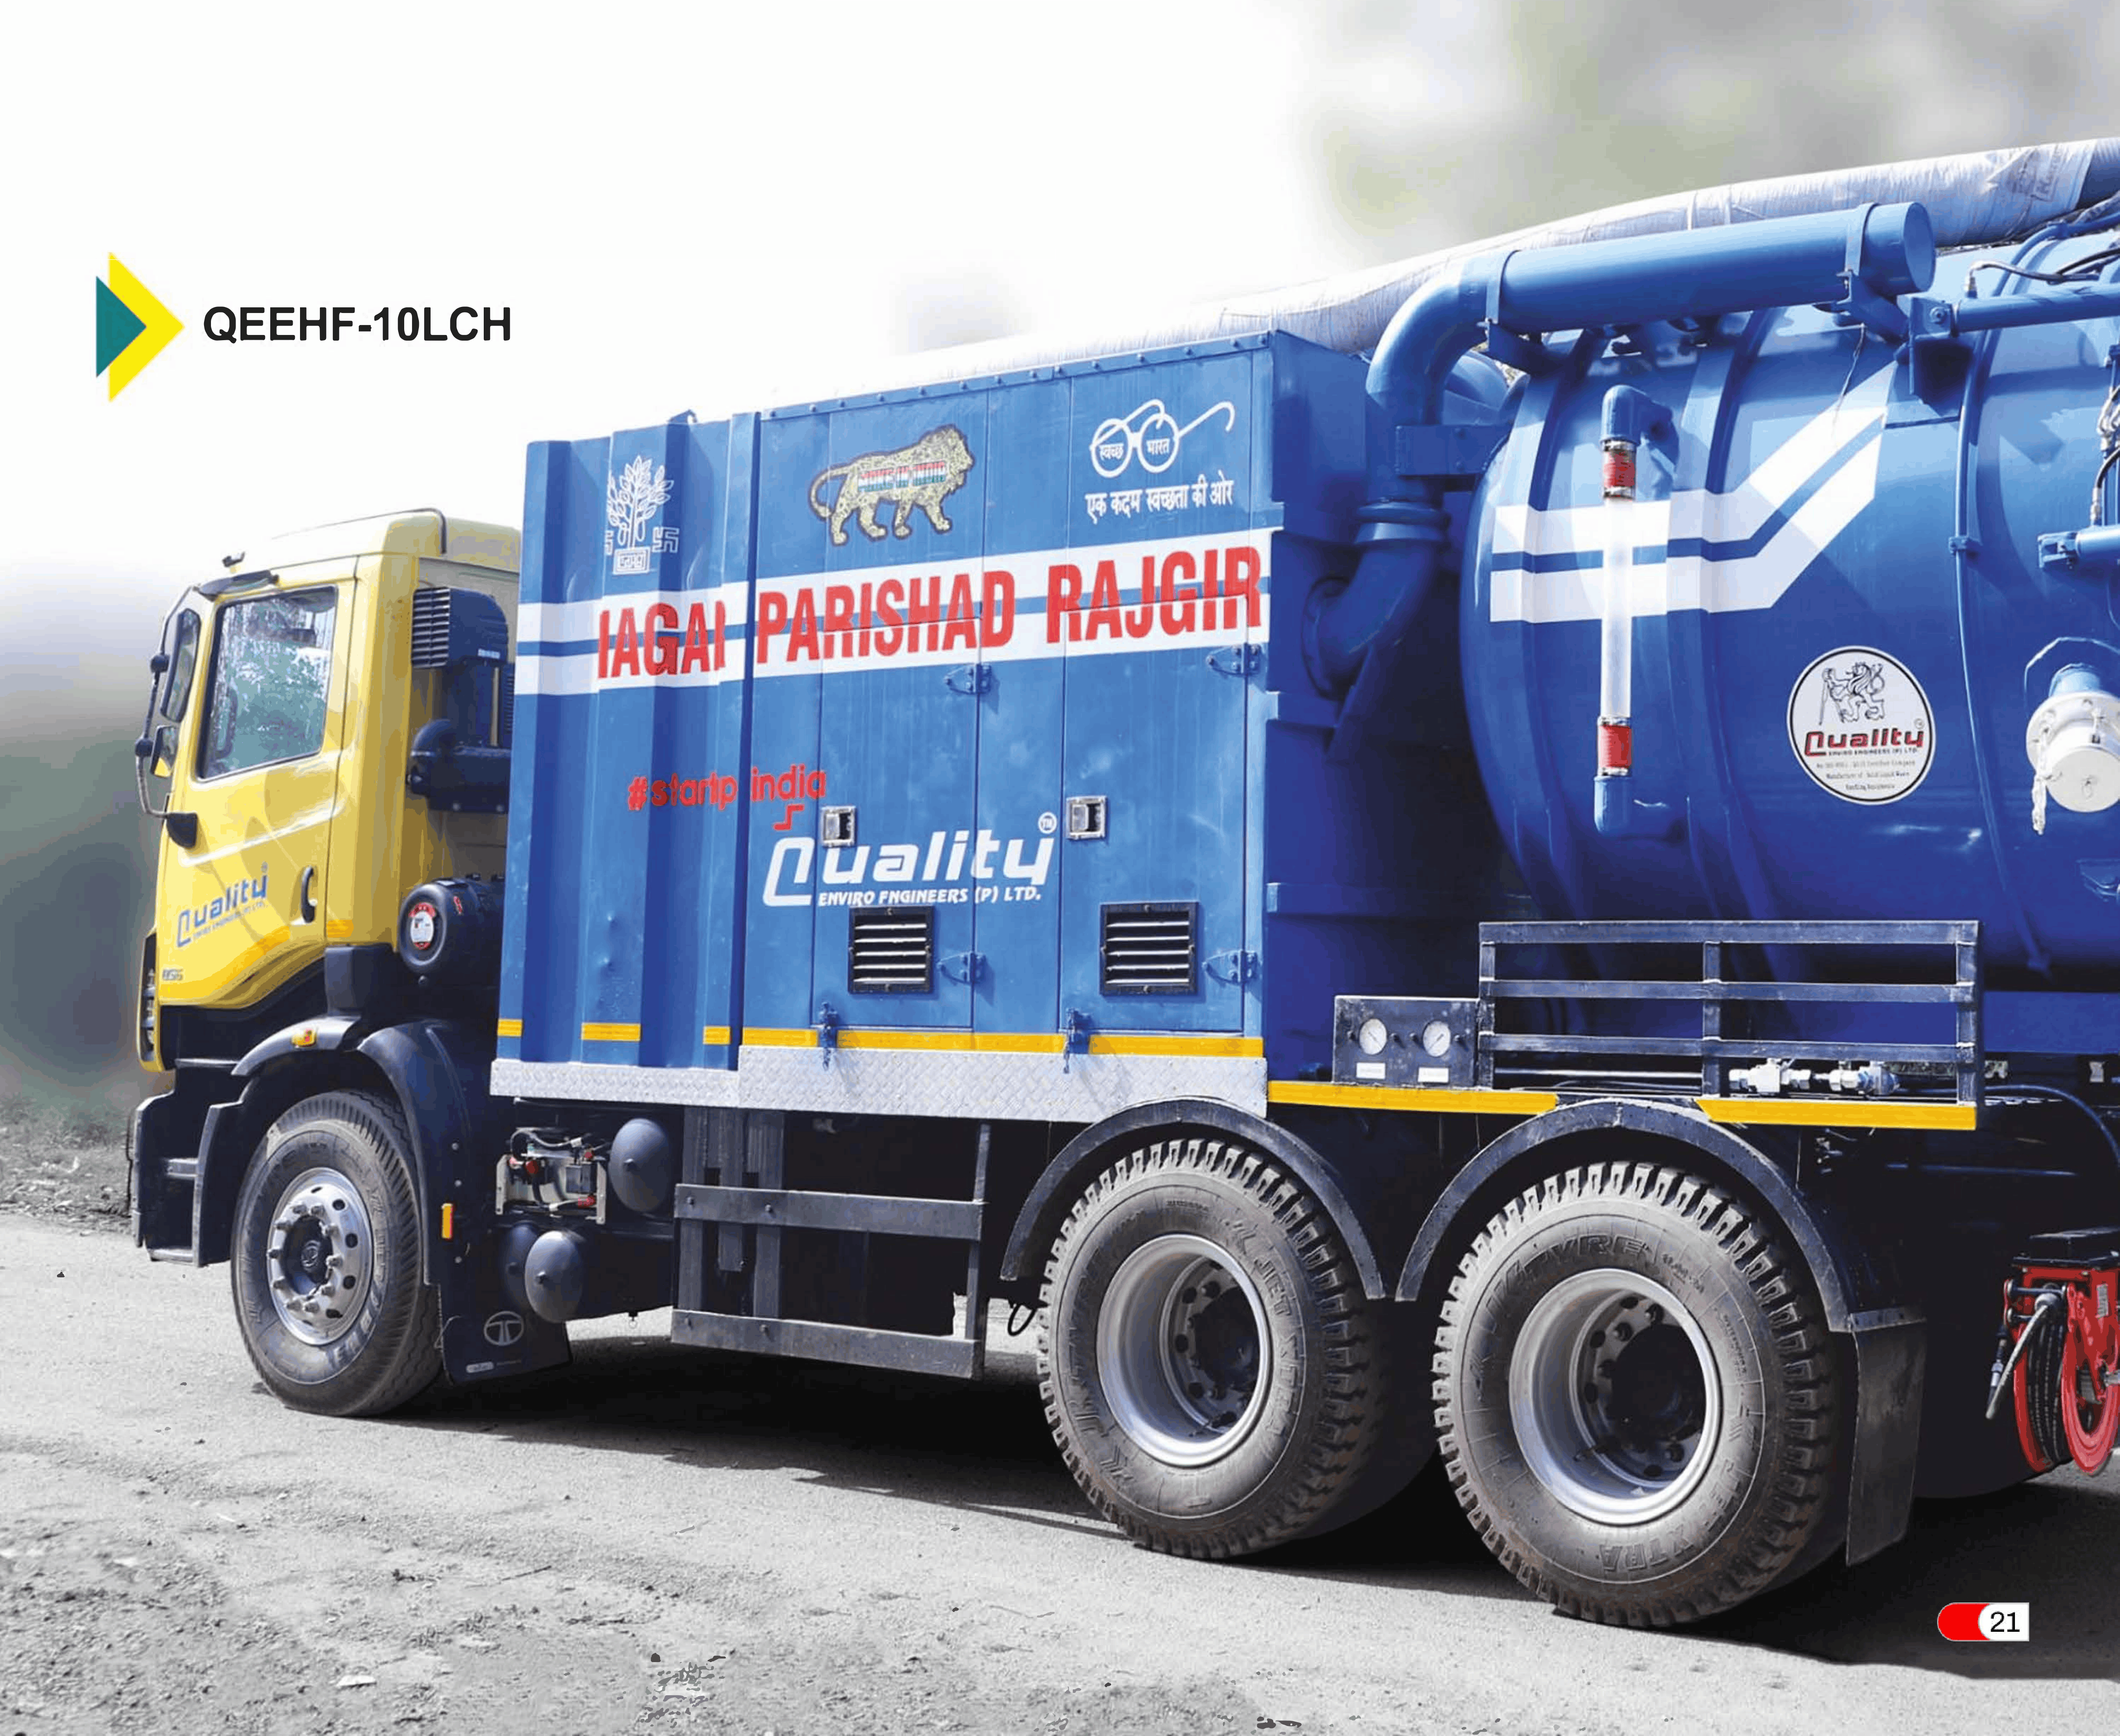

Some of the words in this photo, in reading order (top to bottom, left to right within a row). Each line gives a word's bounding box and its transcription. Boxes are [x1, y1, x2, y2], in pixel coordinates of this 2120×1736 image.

[1146, 438, 1171, 455] भारत
[1085, 492, 1108, 524] एक
[1109, 488, 1143, 518] कदम
[1146, 484, 1190, 512] स्वच्छता
[1191, 473, 1209, 508] की
[1210, 469, 1235, 505] ओर
[756, 570, 1015, 664] PARISHAD
[1045, 546, 1261, 645] RAJGIR
[1804, 727, 1924, 756] Quality
[750, 763, 826, 802] india
[763, 829, 1055, 907] Quality
[177, 875, 267, 948] Quality
[818, 891, 875, 906] ENVIRO
[974, 886, 998, 903] (P)
[1004, 885, 1041, 901] LTD.
